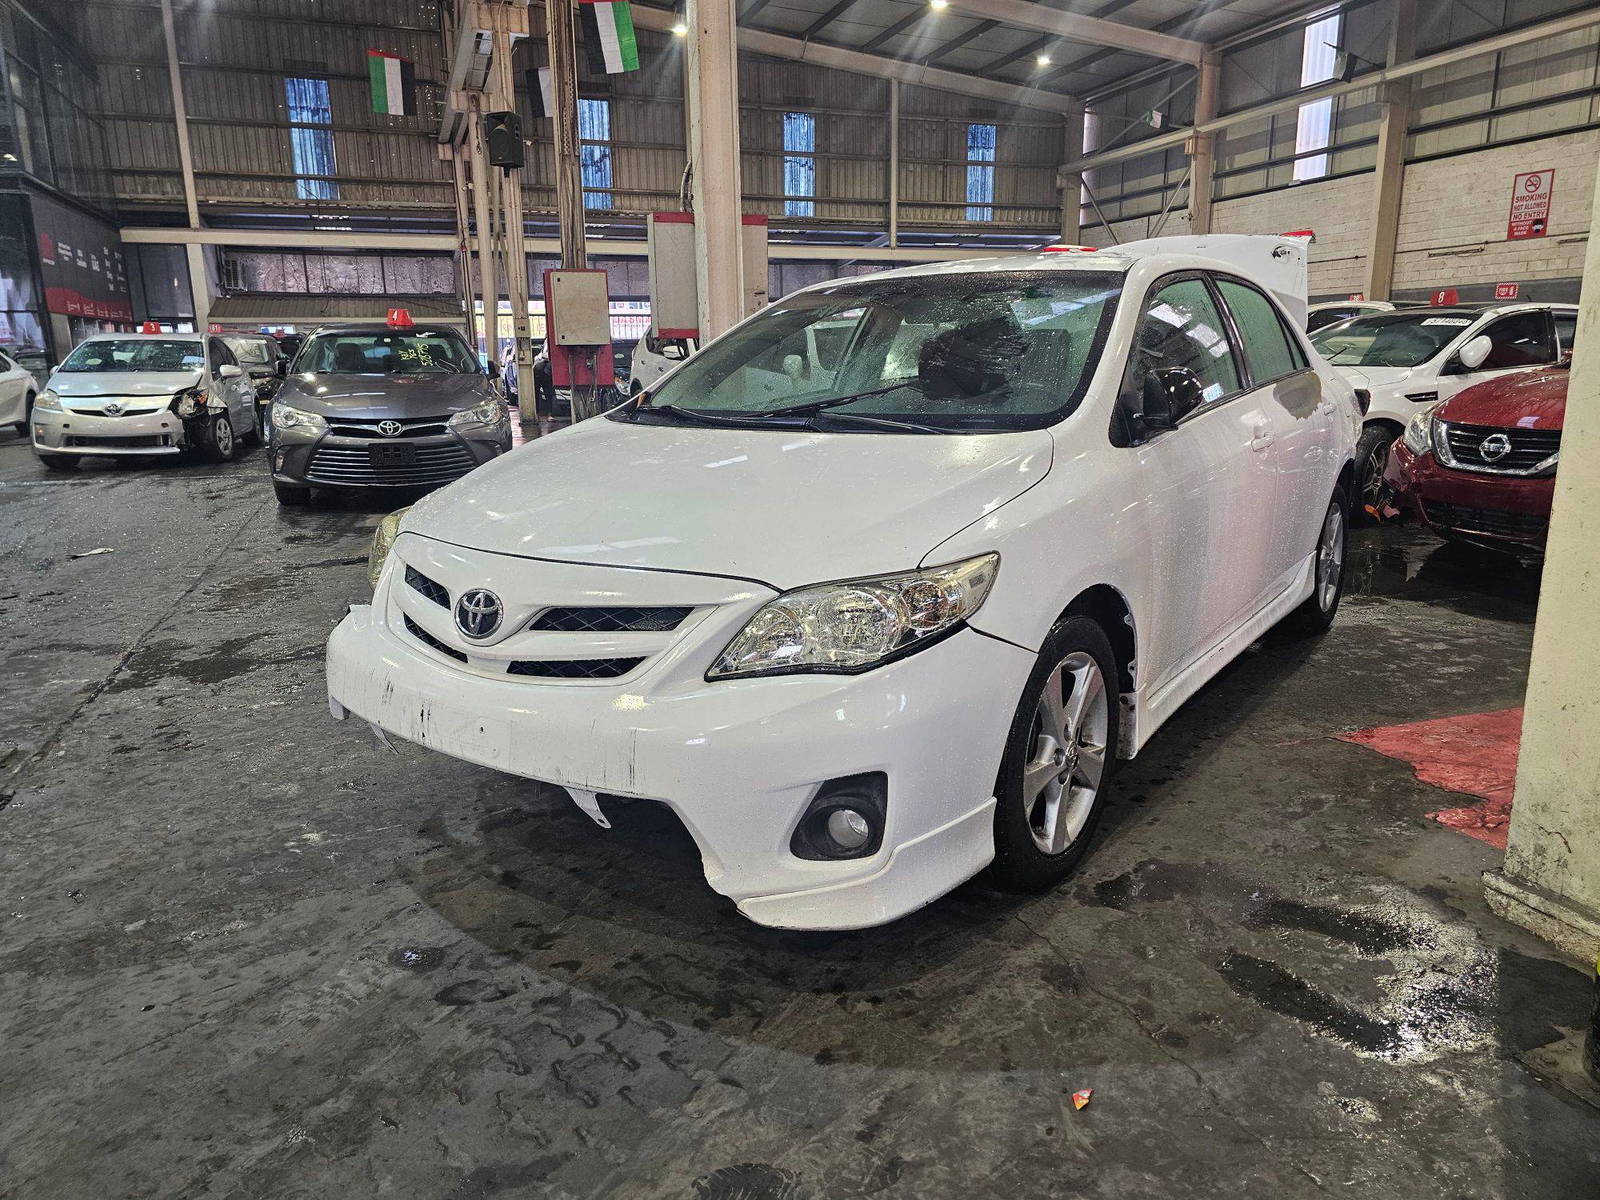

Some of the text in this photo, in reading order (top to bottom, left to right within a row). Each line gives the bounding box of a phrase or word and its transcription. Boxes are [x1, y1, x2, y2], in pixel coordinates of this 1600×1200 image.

[1515, 192, 1547, 203] SMOKING
[1524, 201, 1546, 210] ALLOWED
[1524, 210, 1545, 218] ENTRY
[1437, 291, 1445, 304] 8
[392, 310, 398, 321] 4
[149, 323, 156, 332] 3
